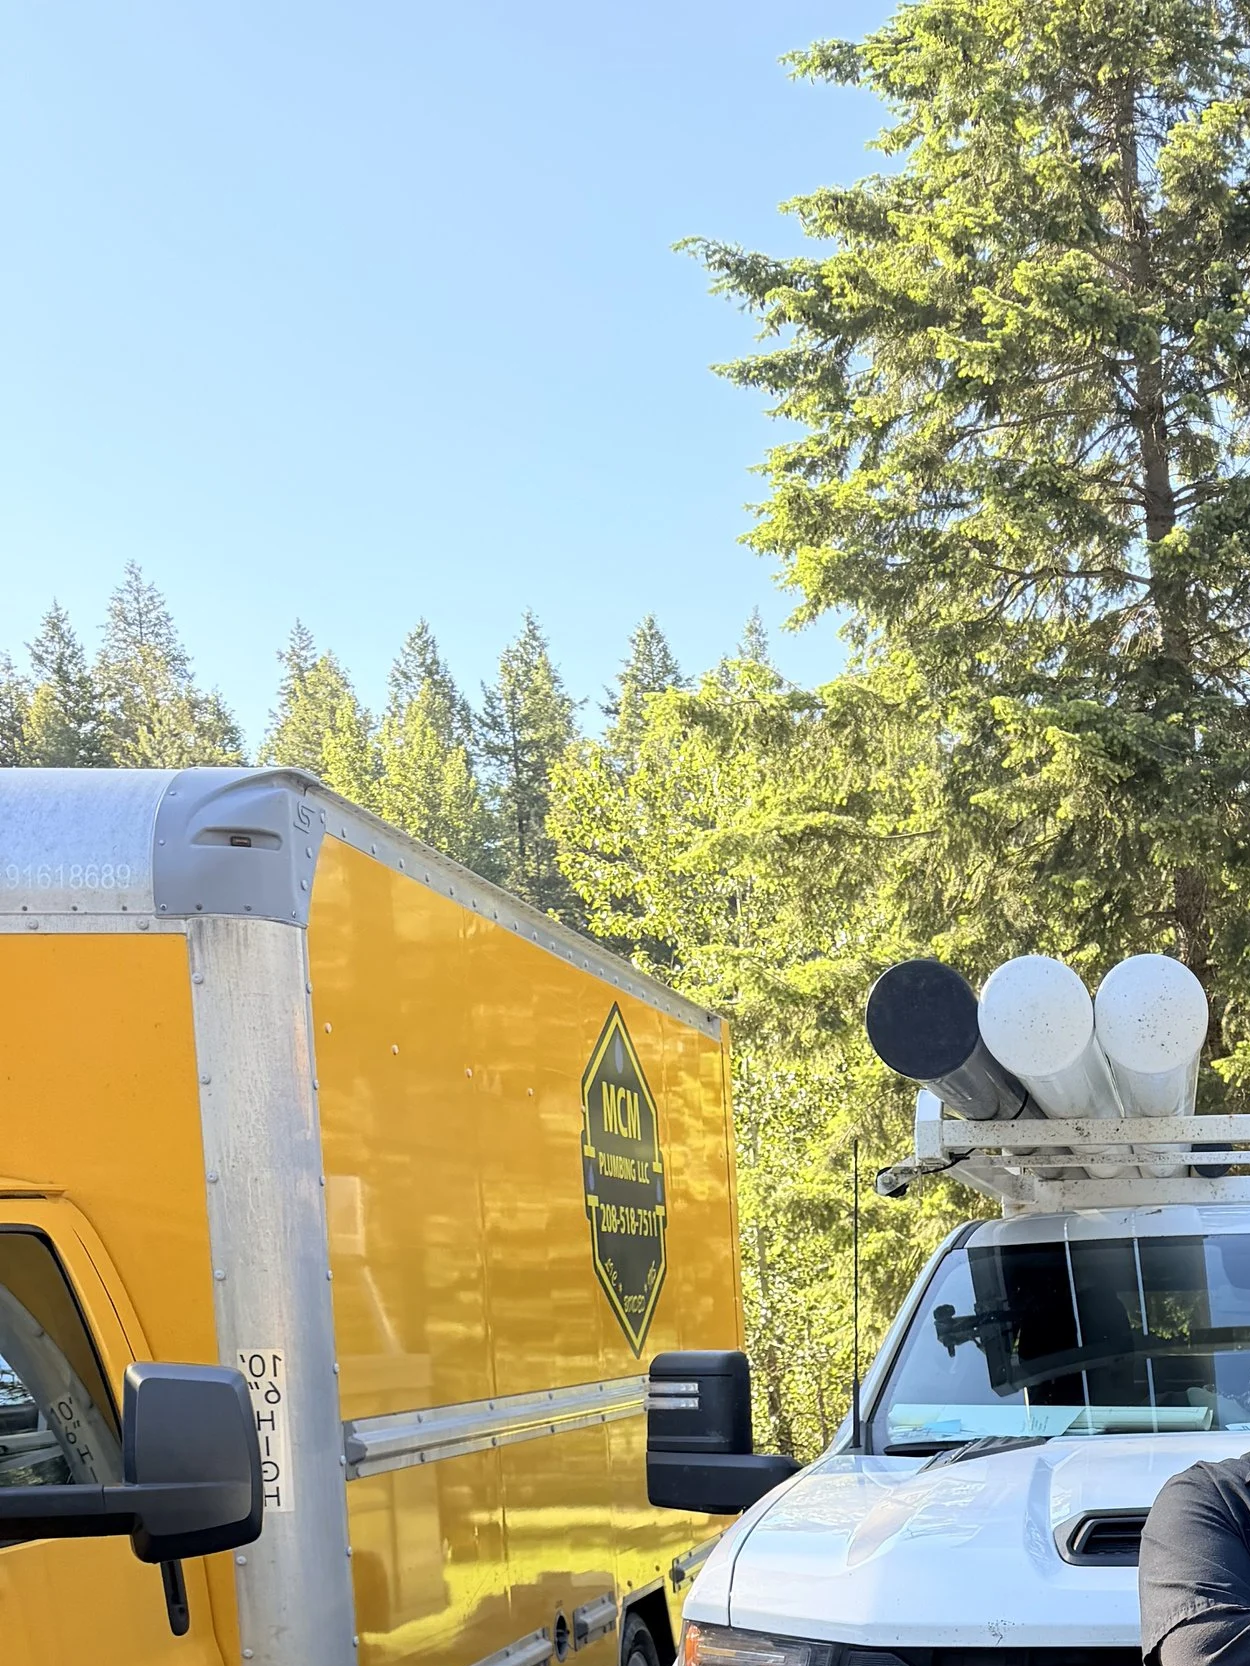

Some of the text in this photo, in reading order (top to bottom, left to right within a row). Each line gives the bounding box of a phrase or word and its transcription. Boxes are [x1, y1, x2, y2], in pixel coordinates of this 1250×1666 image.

[602, 1081, 641, 1141] MCM
[598, 1151, 650, 1185] PLUMBING LLC
[600, 1203, 658, 1237] 208-518-7511
